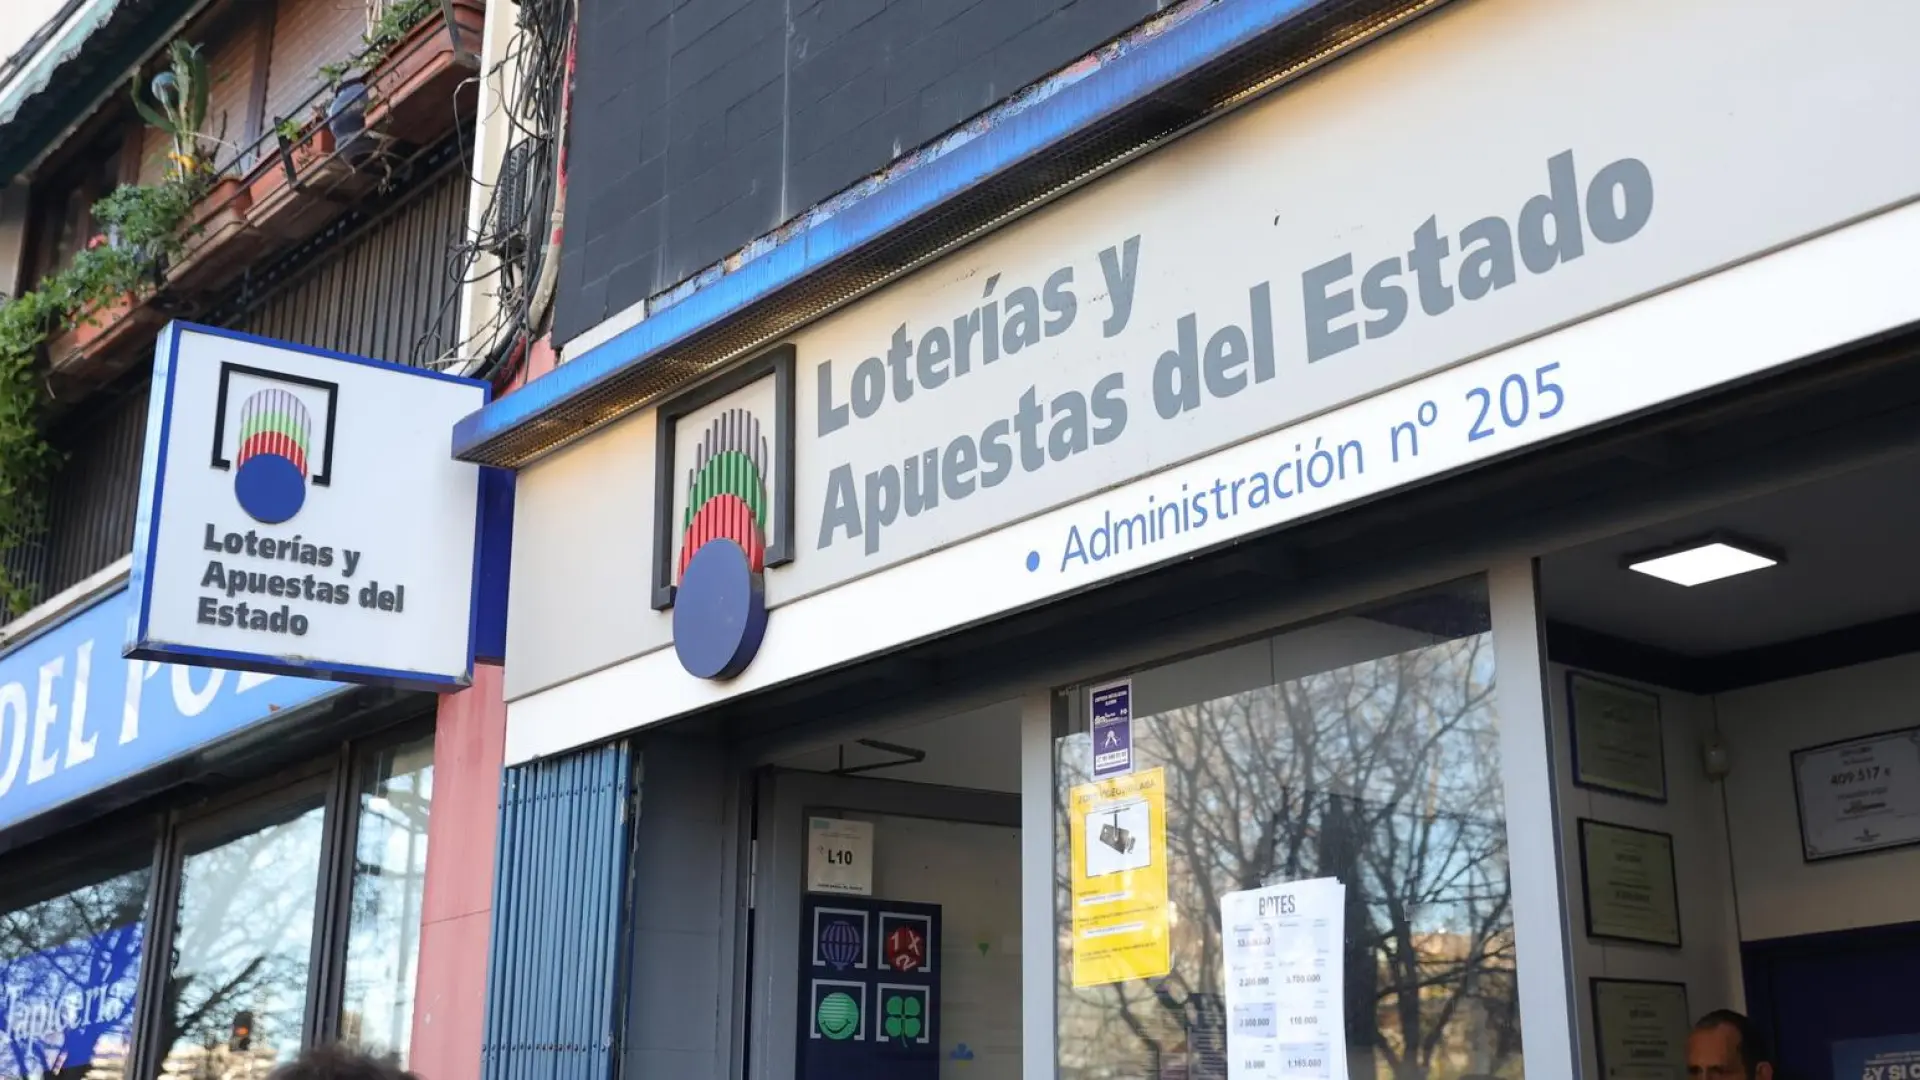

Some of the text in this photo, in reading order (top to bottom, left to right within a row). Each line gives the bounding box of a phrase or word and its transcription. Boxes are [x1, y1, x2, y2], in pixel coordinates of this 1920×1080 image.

[816, 148, 1654, 556] Apuestas del Estado
[817, 233, 1141, 438] Loterías y
[1060, 436, 1364, 573] Administración
[1464, 361, 1565, 443] 205
[203, 522, 361, 578] Loterías y
[200, 560, 405, 613] Apuestas del
[197, 596, 309, 636] Estado
[828, 849, 853, 865] L10
